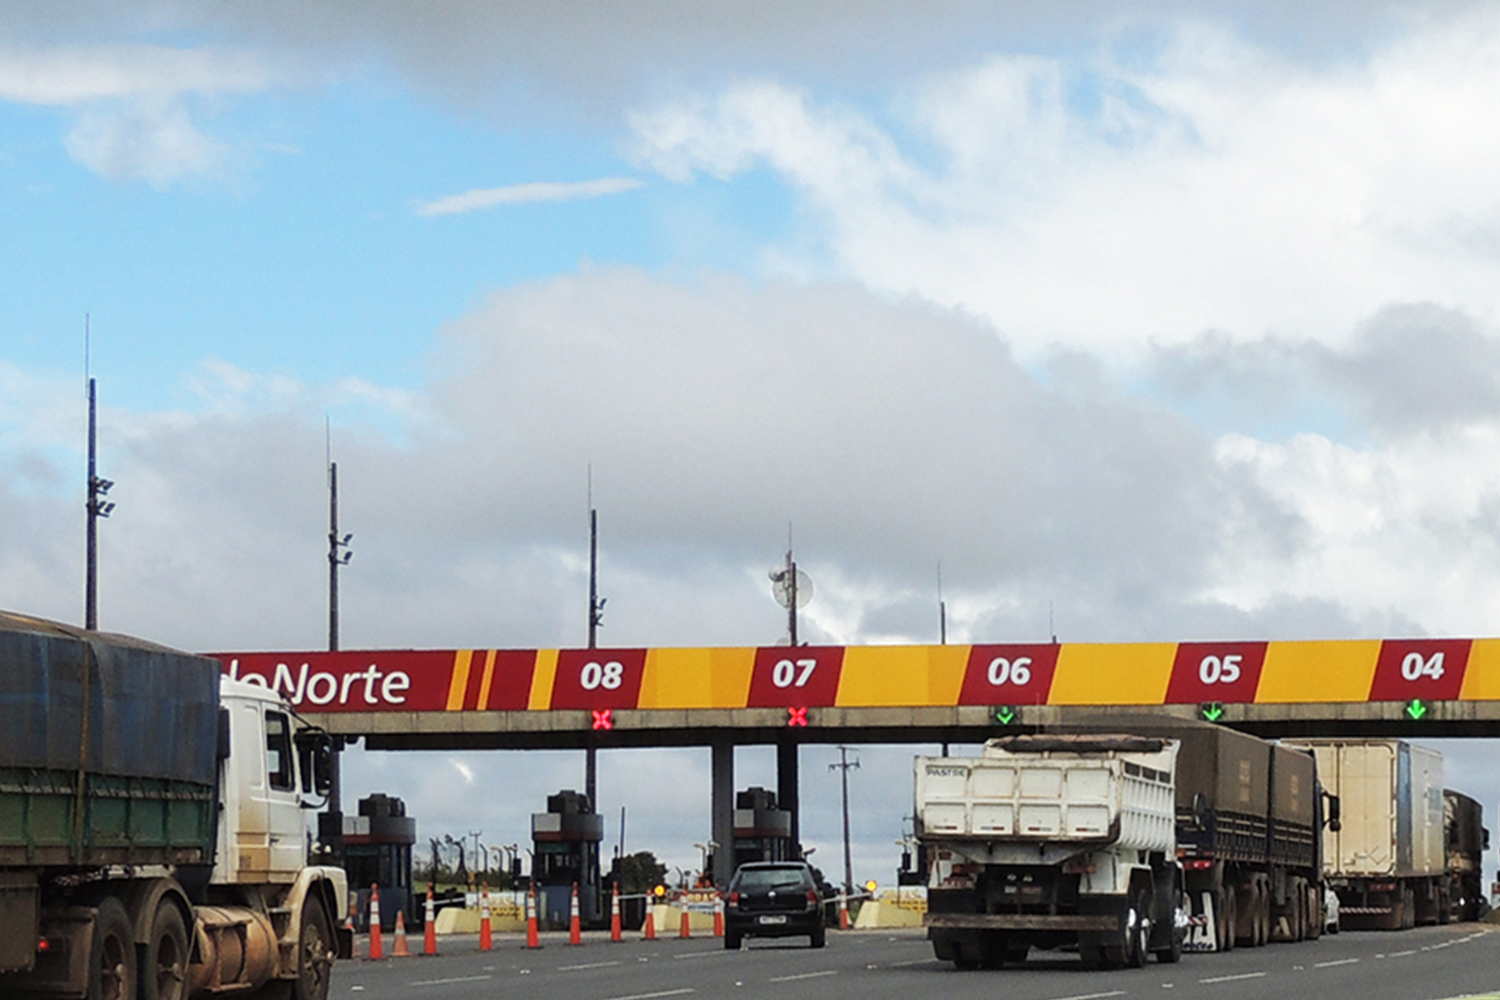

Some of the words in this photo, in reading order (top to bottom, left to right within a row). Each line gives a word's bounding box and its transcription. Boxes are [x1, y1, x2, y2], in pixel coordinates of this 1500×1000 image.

[580, 661, 623, 690] 08
[773, 659, 817, 688] 07
[987, 657, 1032, 686] 06
[1199, 655, 1242, 684] 05
[1401, 652, 1445, 681] 04
